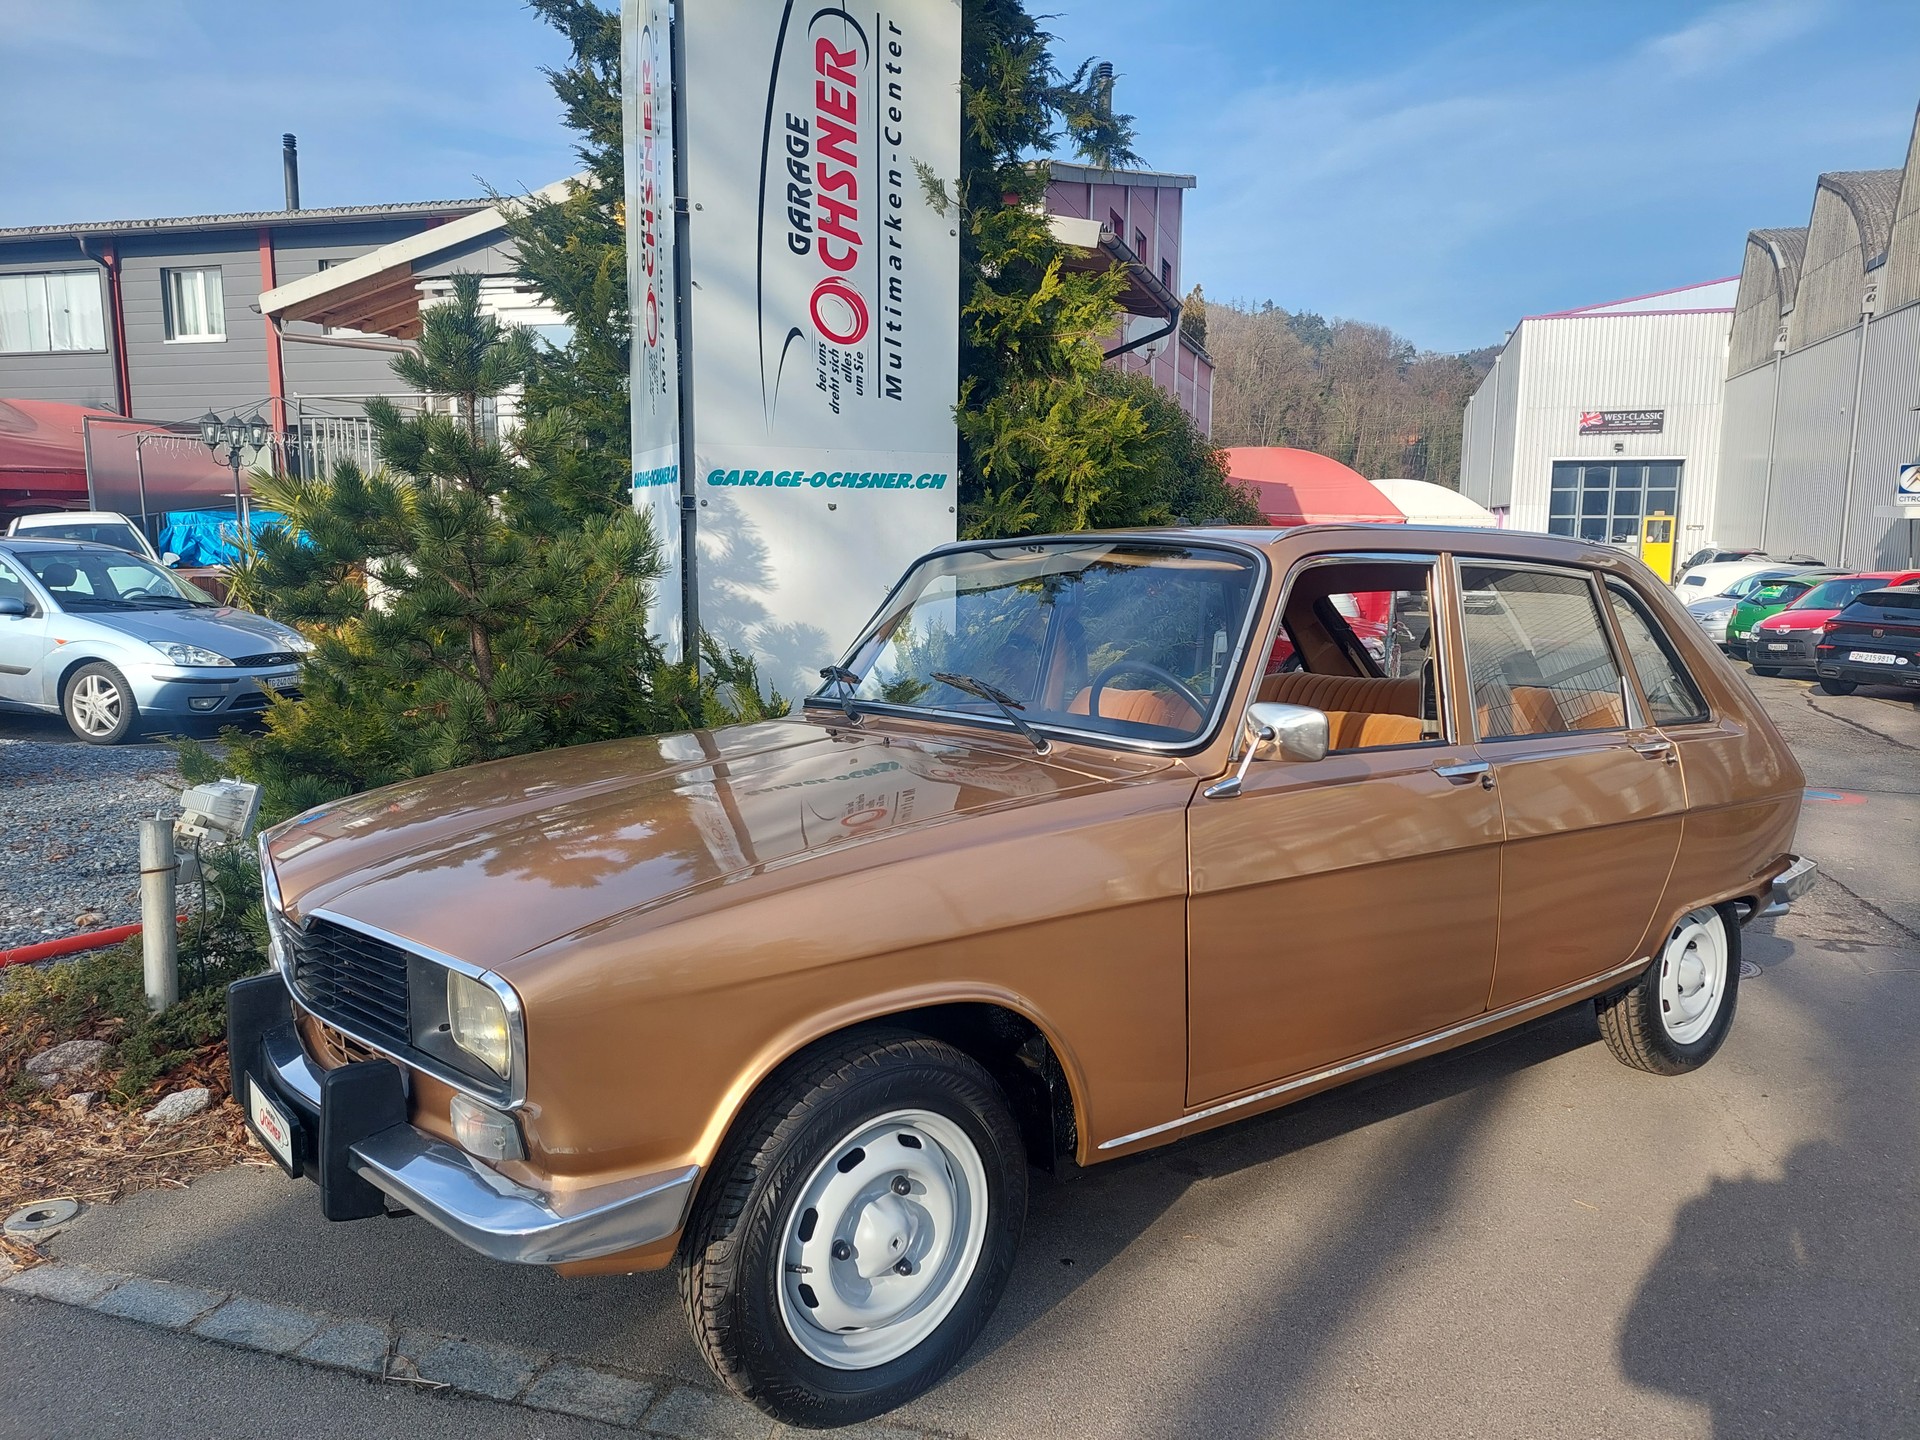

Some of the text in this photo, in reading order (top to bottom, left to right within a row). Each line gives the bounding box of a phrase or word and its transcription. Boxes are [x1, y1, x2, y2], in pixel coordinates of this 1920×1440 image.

[786, 112, 813, 256] GARAGE
[809, 37, 869, 345] OCHSNER
[884, 20, 902, 402] Multimarken-Center
[816, 341, 827, 392] bei uns
[828, 348, 840, 414] dreht sich
[841, 351, 852, 383] alles
[853, 351, 864, 396] um Sie
[1604, 412, 1663, 421] WEST-CLASSIC
[633, 464, 679, 489] GARAGE-OCHSNER.CH
[707, 468, 947, 490] GARAGE-OCHSNER.CH
